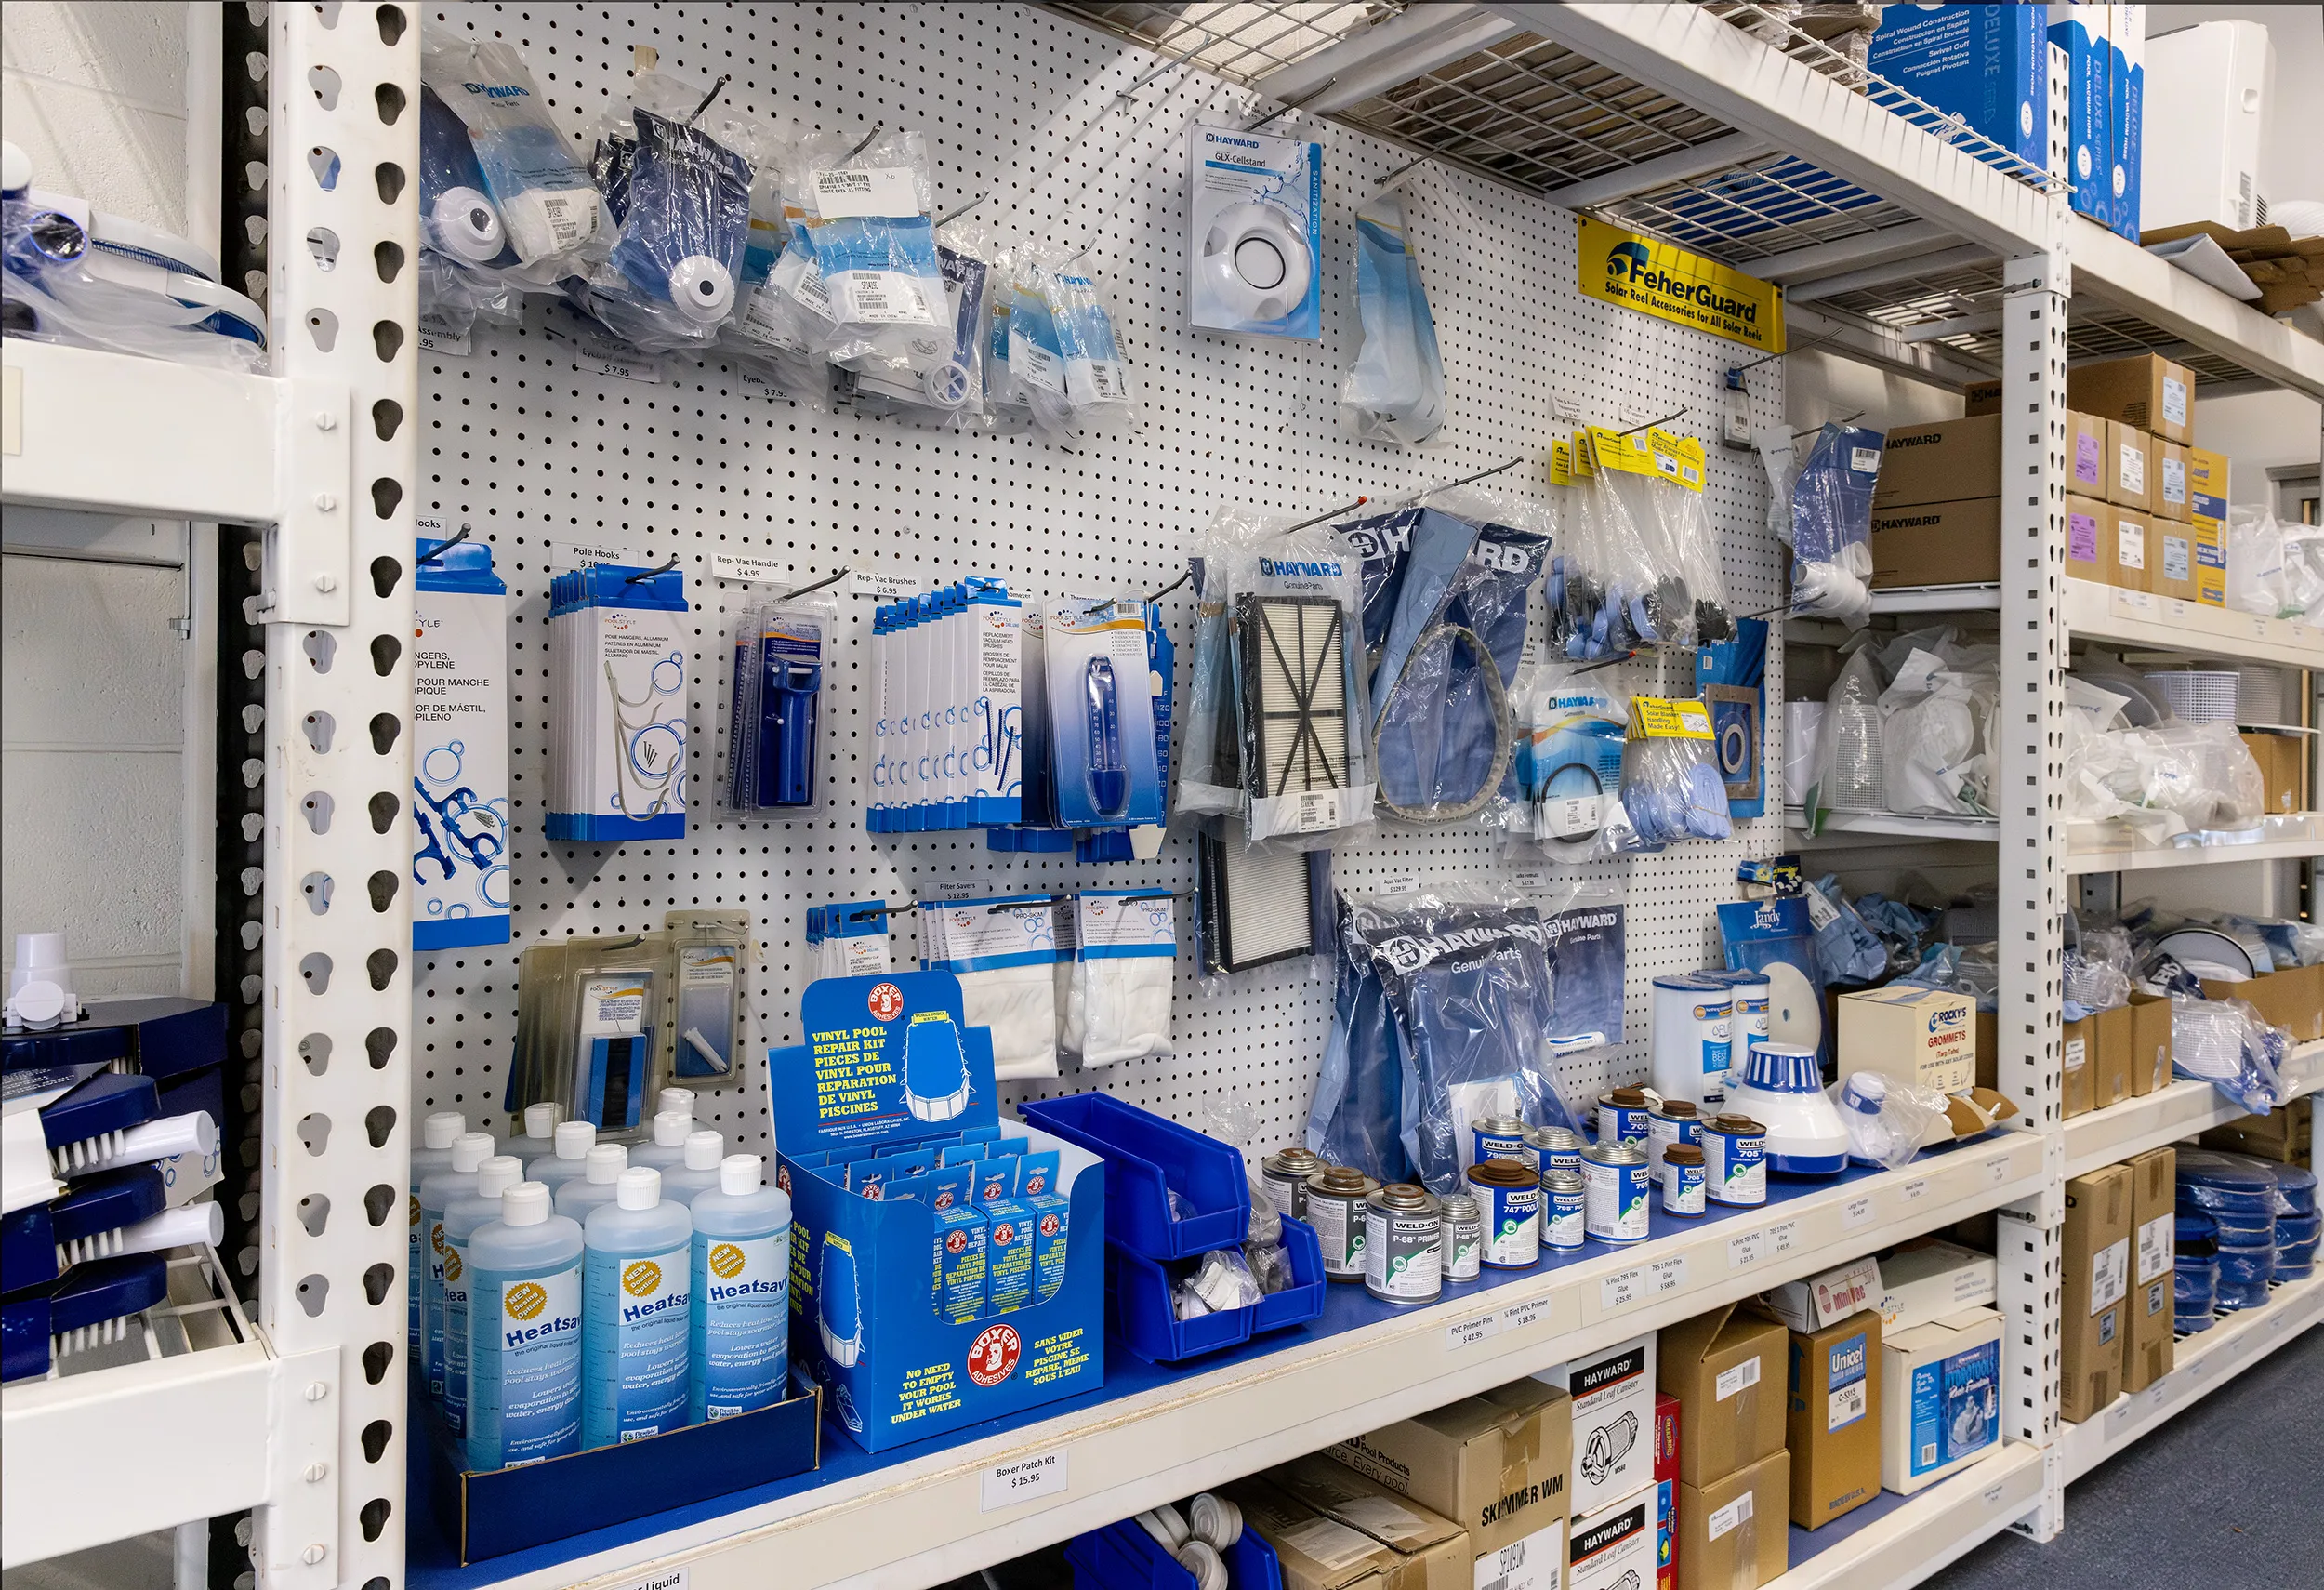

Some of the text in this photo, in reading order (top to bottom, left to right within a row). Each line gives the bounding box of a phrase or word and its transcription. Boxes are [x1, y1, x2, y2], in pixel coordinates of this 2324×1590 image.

[1875, 9, 1970, 42] Spiral Wound Construction
[1893, 27, 1935, 46] Construccion
[1947, 18, 1970, 30] Espiral
[1873, 43, 1913, 59] Construction
[1923, 34, 1943, 46] Spiral
[1929, 40, 1970, 58] Swivel Cuff
[1984, 4, 2000, 78] DELUXE
[1942, 51, 1970, 63] Rotativa
[1916, 59, 1969, 78] Poignet Pivotant
[2094, 60, 2103, 130] DELUXE
[1215, 136, 1259, 149] HAYWARD
[1215, 152, 1265, 167] GLX-Cellstand
[1630, 257, 1757, 324] FeherGuard
[1605, 281, 1762, 342] Solar Reel Accessories for All Solar Reels
[604, 364, 630, 378] $ 7.95
[1881, 515, 1941, 530] HAYWARD
[573, 547, 620, 560] Pole Hooks
[718, 556, 778, 568] Rep- Vac Handle
[737, 567, 759, 577] $ 4.95
[1274, 562, 1342, 578] HAYWARD
[857, 574, 916, 586] Rep- Vac Brushes
[877, 586, 881, 594] $
[417, 678, 490, 687] POUR MANCHE
[431, 703, 486, 713] DE MÁSTIL,
[1563, 913, 1618, 933] HAYWARD
[1755, 909, 1780, 928] Jandy
[870, 986, 901, 1003] BOXER
[872, 1006, 901, 1021] ADHESIVES
[1938, 1007, 1966, 1022] ROCKY'S
[812, 1027, 887, 1043] VINYL POOL
[1928, 1030, 1966, 1048] GROMMETS
[813, 1039, 885, 1055] REPAIR KIT
[815, 1052, 880, 1067] PIECES DE
[816, 1063, 891, 1080] VINYL POUR
[817, 1074, 897, 1093] REPARATION
[819, 1090, 876, 1106] DE VINYL
[820, 1102, 878, 1119] PISCINES
[1418, 1233, 1440, 1243] PRIMER
[713, 1247, 731, 1262] NEW
[716, 1253, 737, 1269] Dosing
[720, 1258, 743, 1277] Options
[1652, 1264, 1660, 1272] 795
[1665, 1261, 1673, 1269] Pint
[1611, 1277, 1619, 1285] Pint
[1620, 1274, 1630, 1282] 795
[1663, 1272, 1673, 1280] Glue
[1618, 1284, 1629, 1293] Glue
[1510, 1300, 1548, 1317] Pint PVC Primer
[1451, 1317, 1493, 1336] PVC Primer Pint
[1518, 1313, 1537, 1326] $ 18.95
[971, 1328, 1018, 1359] BOXER
[1034, 1328, 1083, 1349] SANS VIDER
[1463, 1331, 1483, 1344] $ 42.95
[1045, 1340, 1073, 1355] VOTRE
[1033, 1347, 1080, 1367] PISCINE SE
[1832, 1344, 1863, 1373] Unicel
[906, 1362, 951, 1380] NO NEED
[971, 1358, 1015, 1384] ADHESIVES
[1025, 1354, 1089, 1379] REPARE, MEME
[1033, 1365, 1081, 1385] SOUS L'EAU
[903, 1371, 955, 1391] TO EMPTY
[899, 1382, 957, 1401] YOUR POOL
[1576, 1379, 1639, 1411] Standard Leaf Canister
[902, 1392, 952, 1411] IT WORKS
[891, 1398, 961, 1424] UNDER WATER
[997, 1455, 1055, 1477] Boxer Patch Kit
[1361, 1442, 1410, 1476] Pool Products
[1011, 1473, 1040, 1489] $ 15.95
[1353, 1456, 1408, 1494] Every pool.
[1481, 1474, 1563, 1527] SKIMMER WM
[646, 1573, 680, 1590] Liquid
